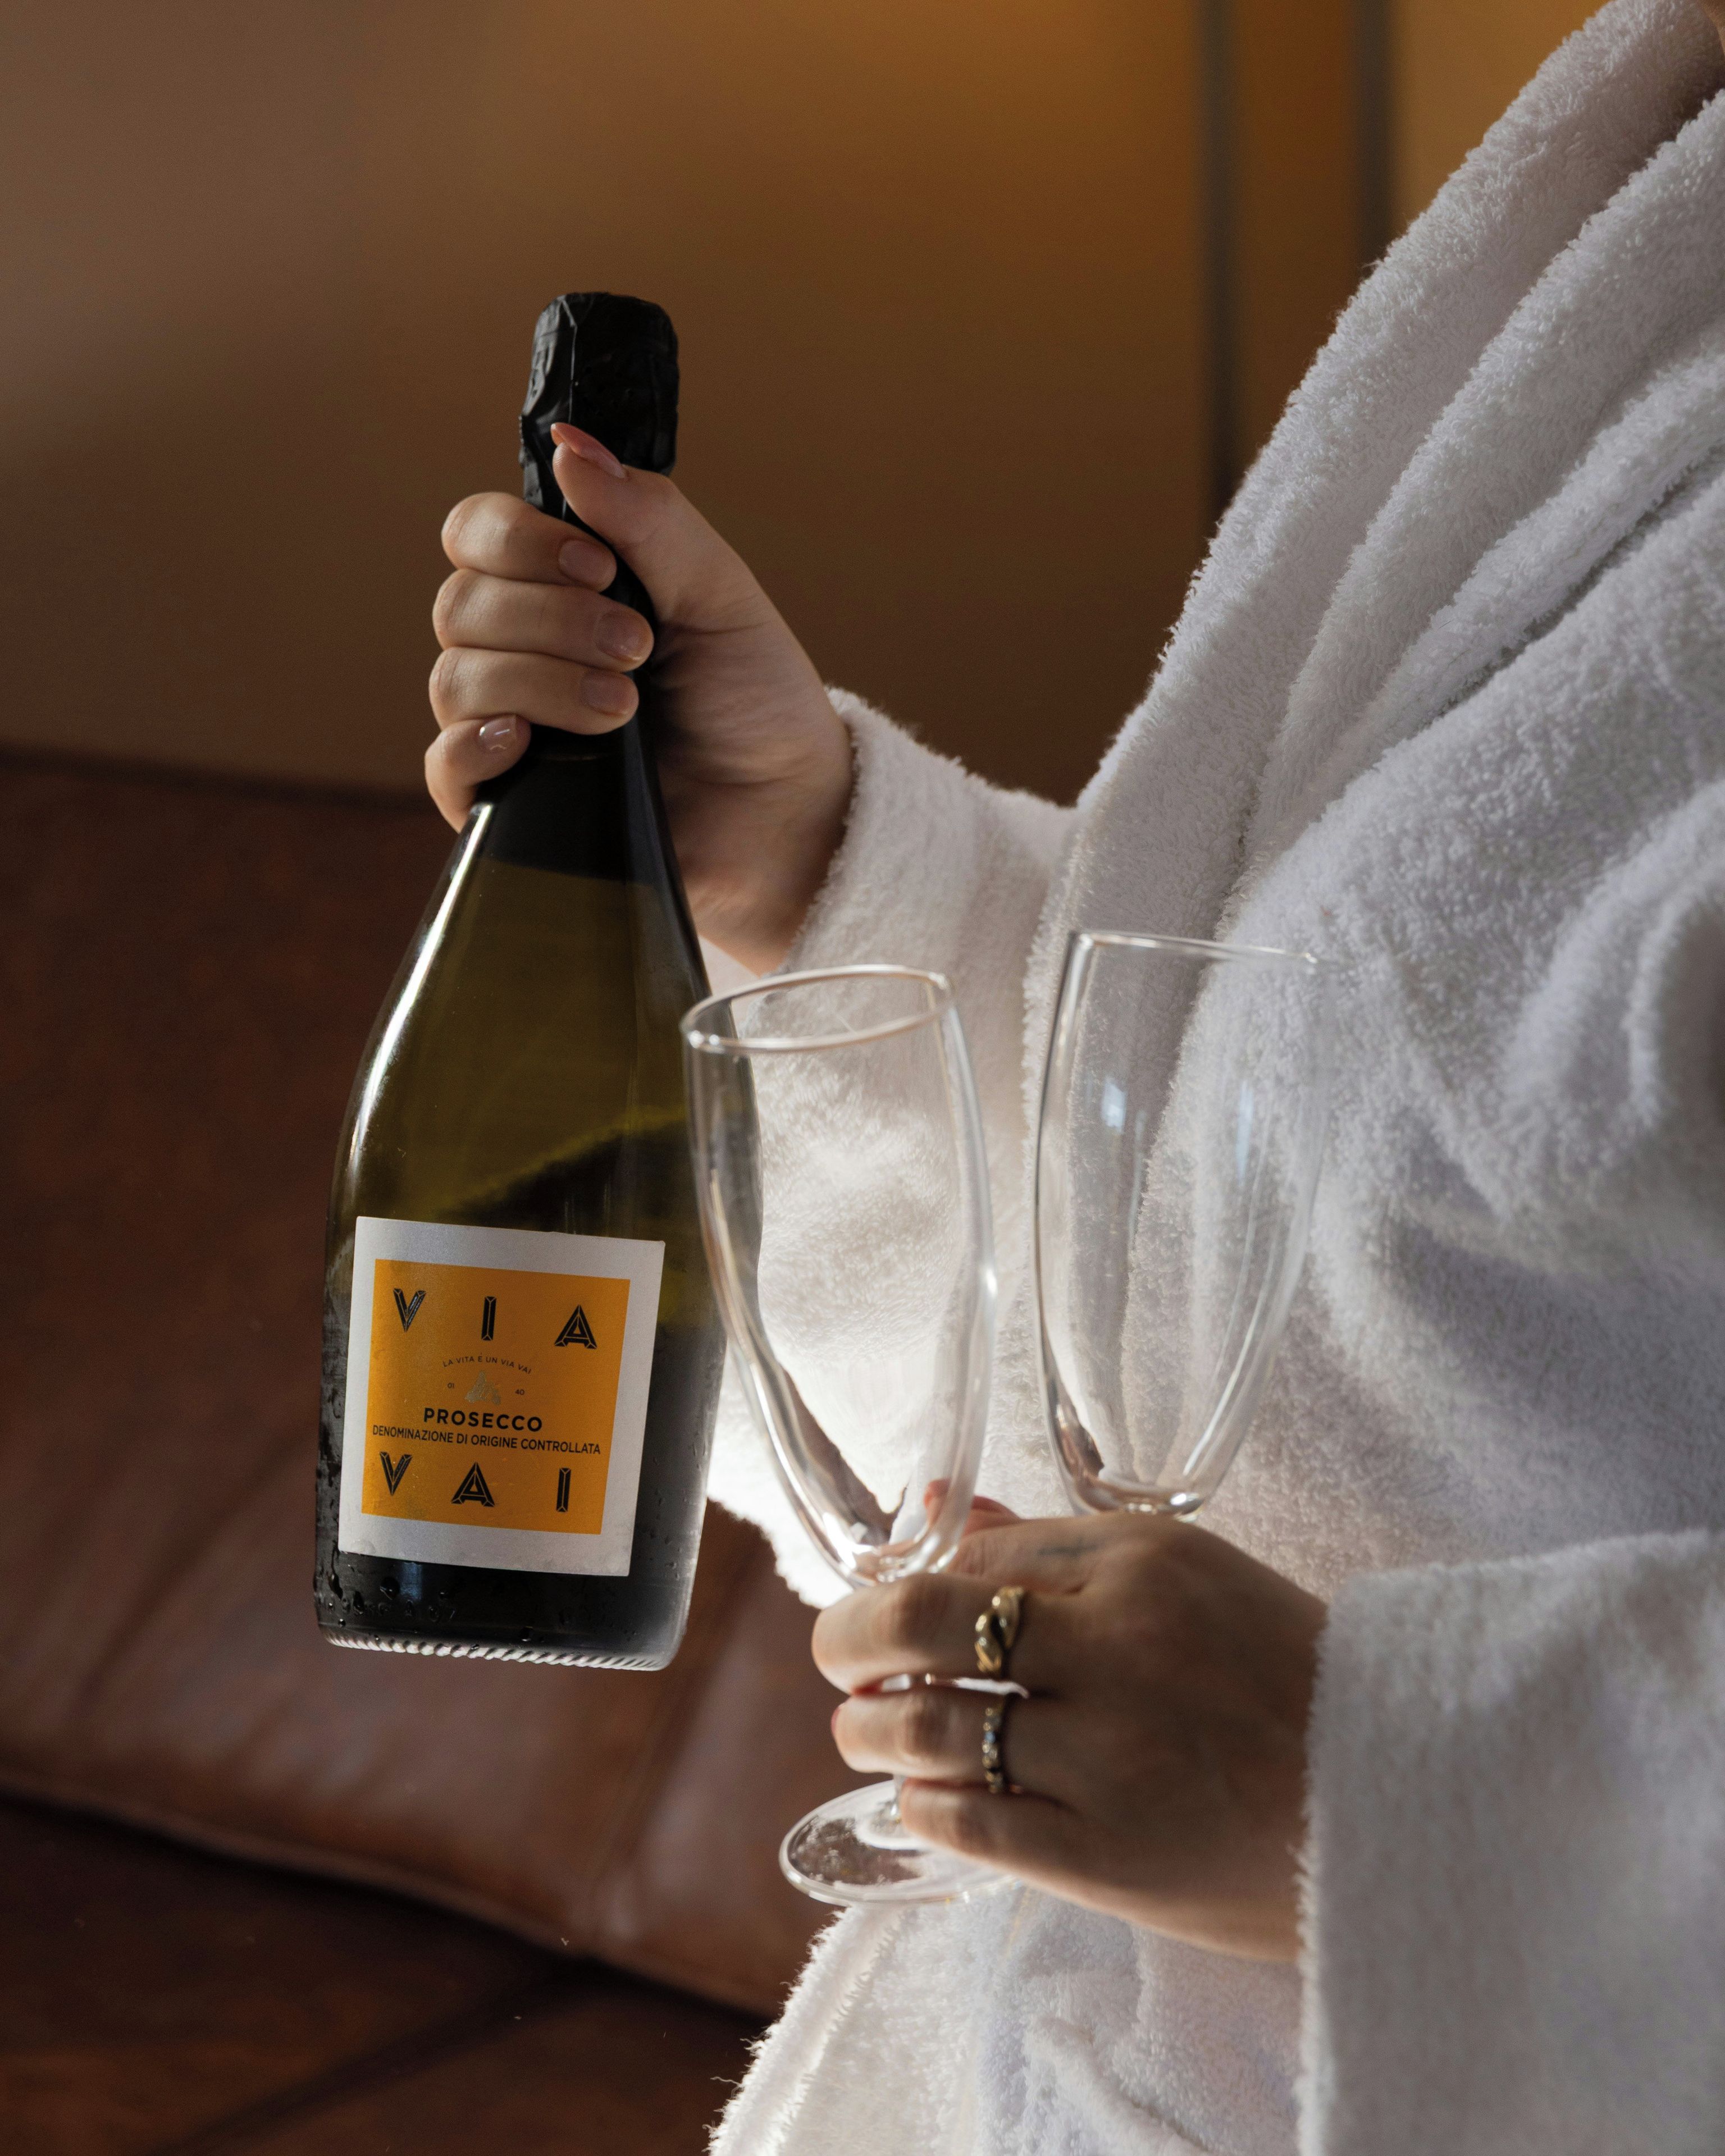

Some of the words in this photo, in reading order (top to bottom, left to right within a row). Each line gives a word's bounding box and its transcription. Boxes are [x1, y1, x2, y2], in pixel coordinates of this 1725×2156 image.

[501, 1359, 515, 1368] VIA
[518, 1364, 532, 1374] VAI
[423, 1408, 542, 1432] PROSECCO
[373, 1425, 453, 1444] DENOMINAZIONE
[457, 1433, 468, 1445] DI
[471, 1435, 517, 1449] ORIGINE
[521, 1439, 601, 1455] CONTROLLATA
